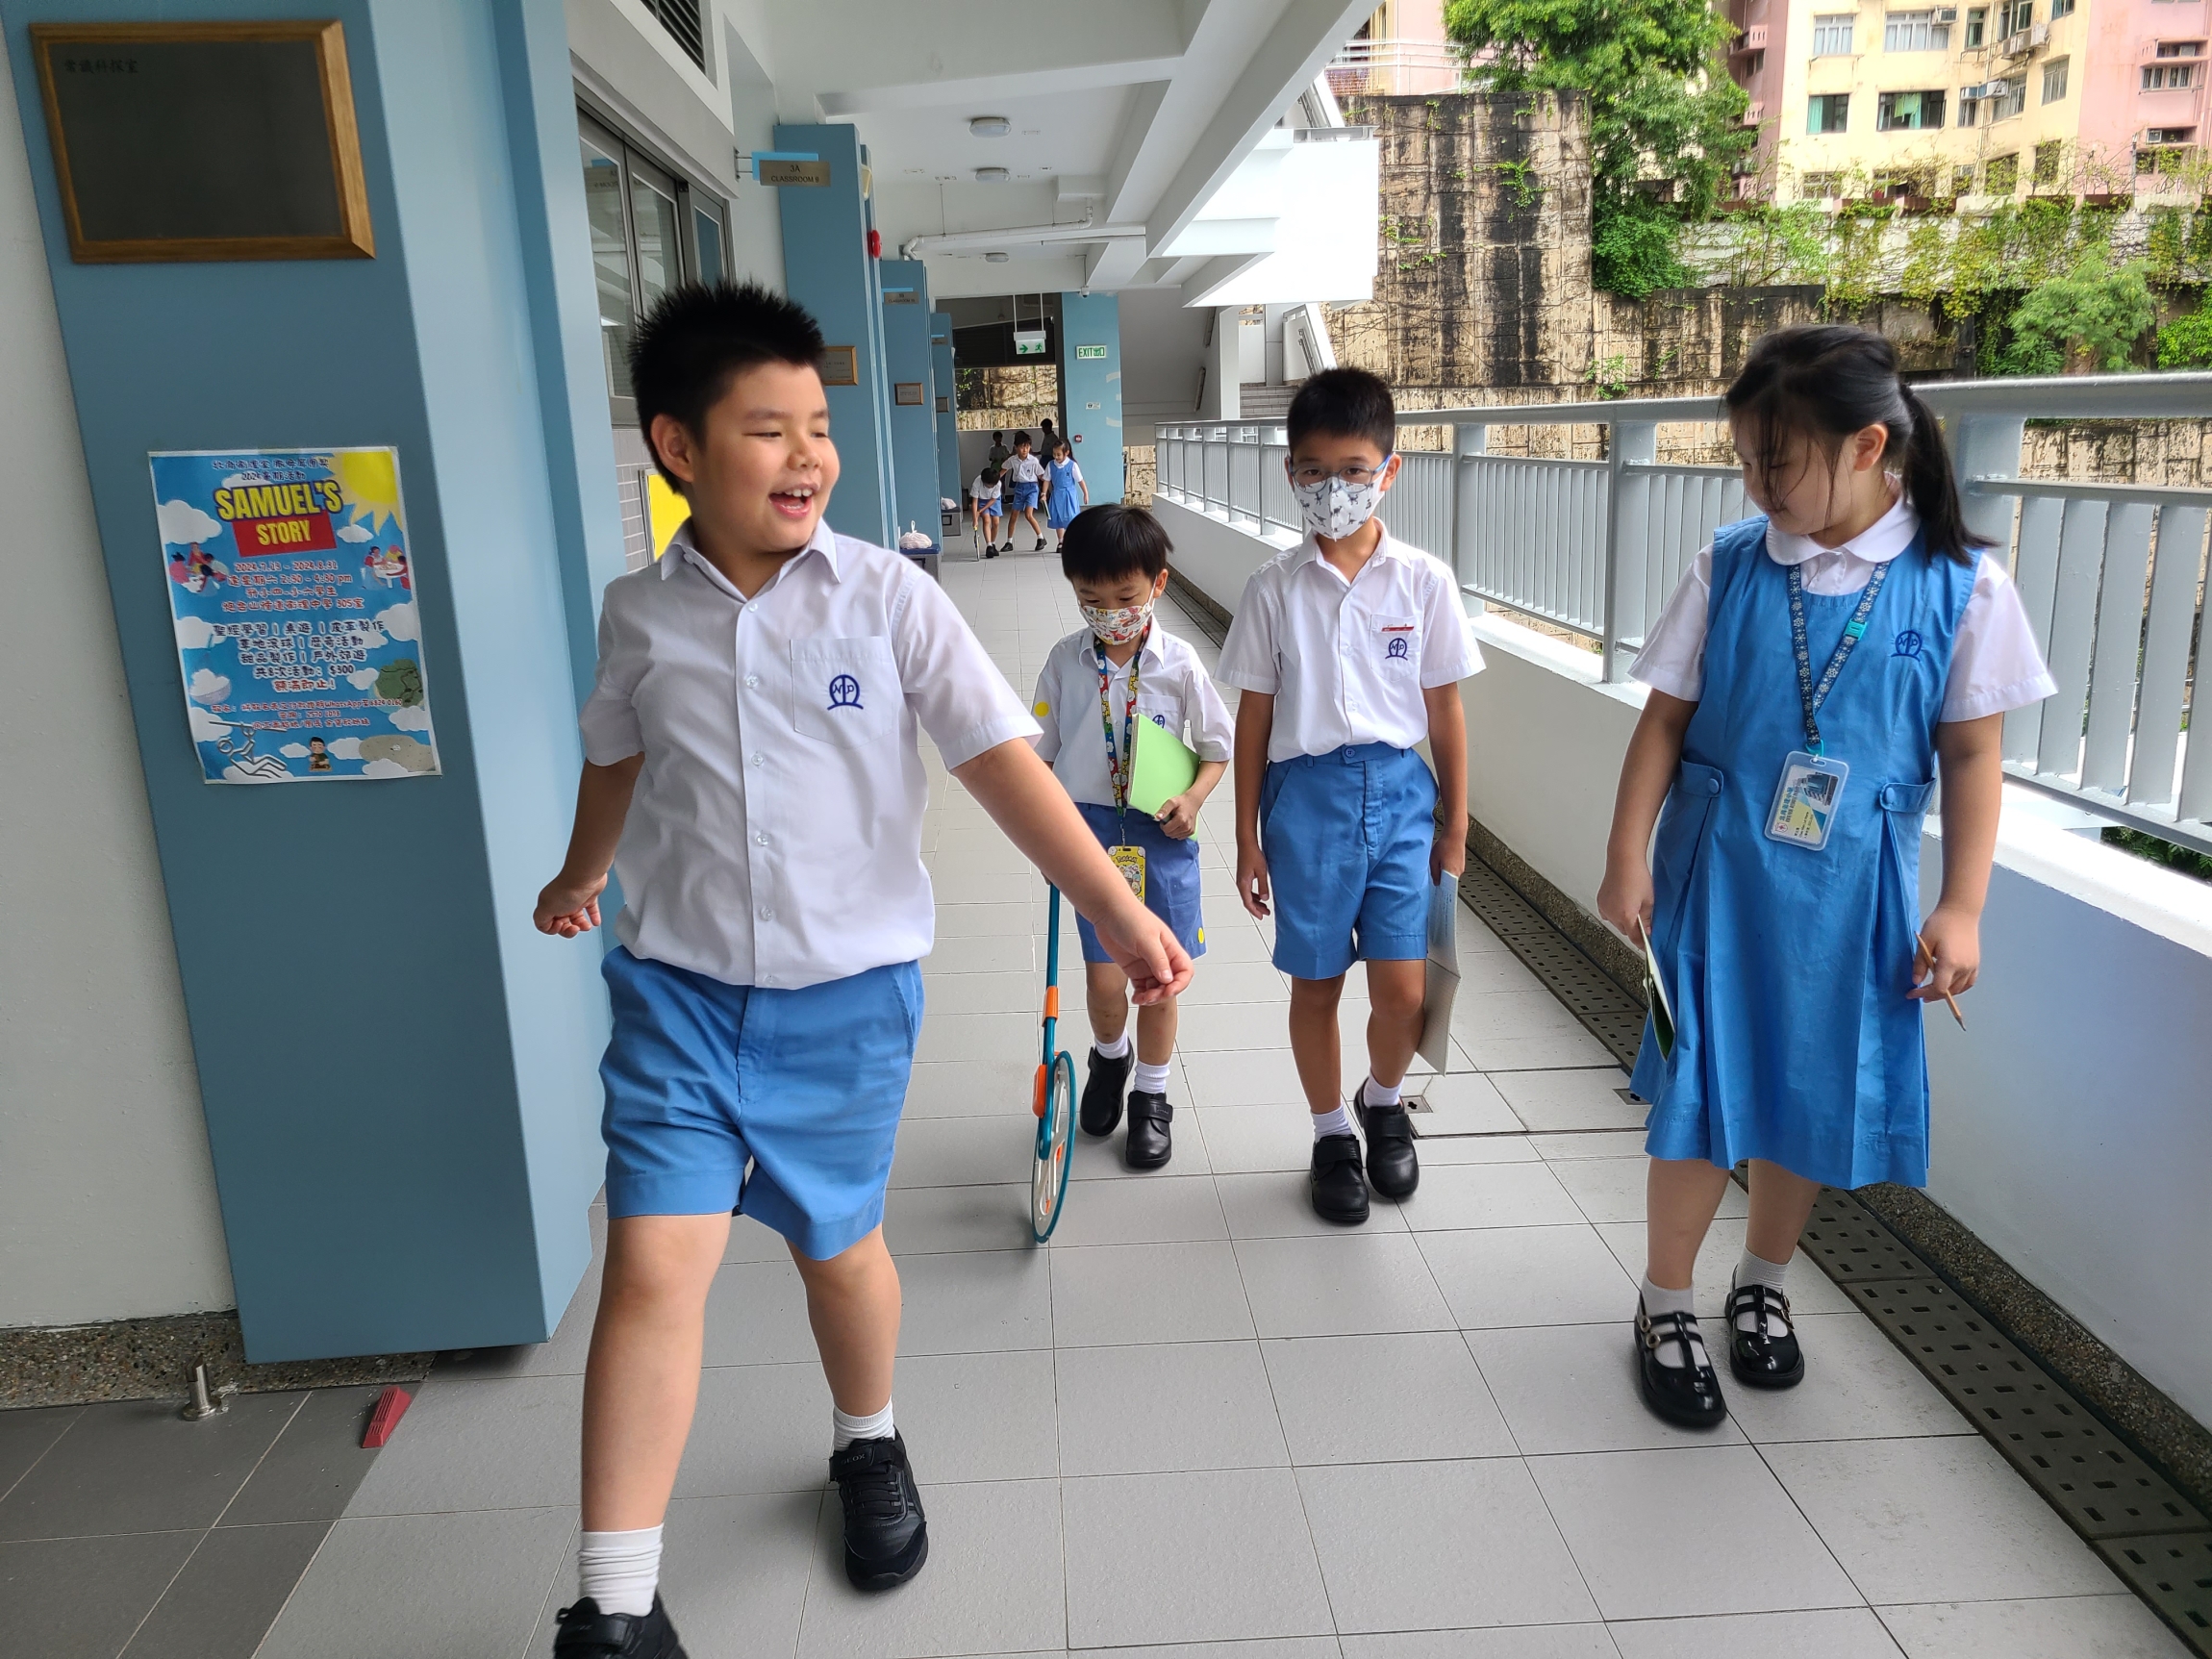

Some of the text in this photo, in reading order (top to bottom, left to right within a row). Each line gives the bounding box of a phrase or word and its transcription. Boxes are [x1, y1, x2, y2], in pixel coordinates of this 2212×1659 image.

[790, 164, 800, 173] 3A
[1078, 347, 1093, 358] EXIT
[214, 480, 343, 521] SAMUEL'S
[256, 519, 312, 546] STORY
[235, 562, 282, 572] 2024.7.13
[292, 561, 338, 571] 2024.8.31
[280, 574, 303, 585] 2:30
[314, 573, 336, 584] 4:30
[338, 574, 352, 585] pm
[338, 597, 364, 609] 305室
[213, 623, 267, 636] 聖經學習
[284, 622, 312, 634] 桌遊
[331, 620, 385, 633] 皮革製作
[240, 651, 295, 664] 甜品製作
[329, 665, 355, 676] $300
